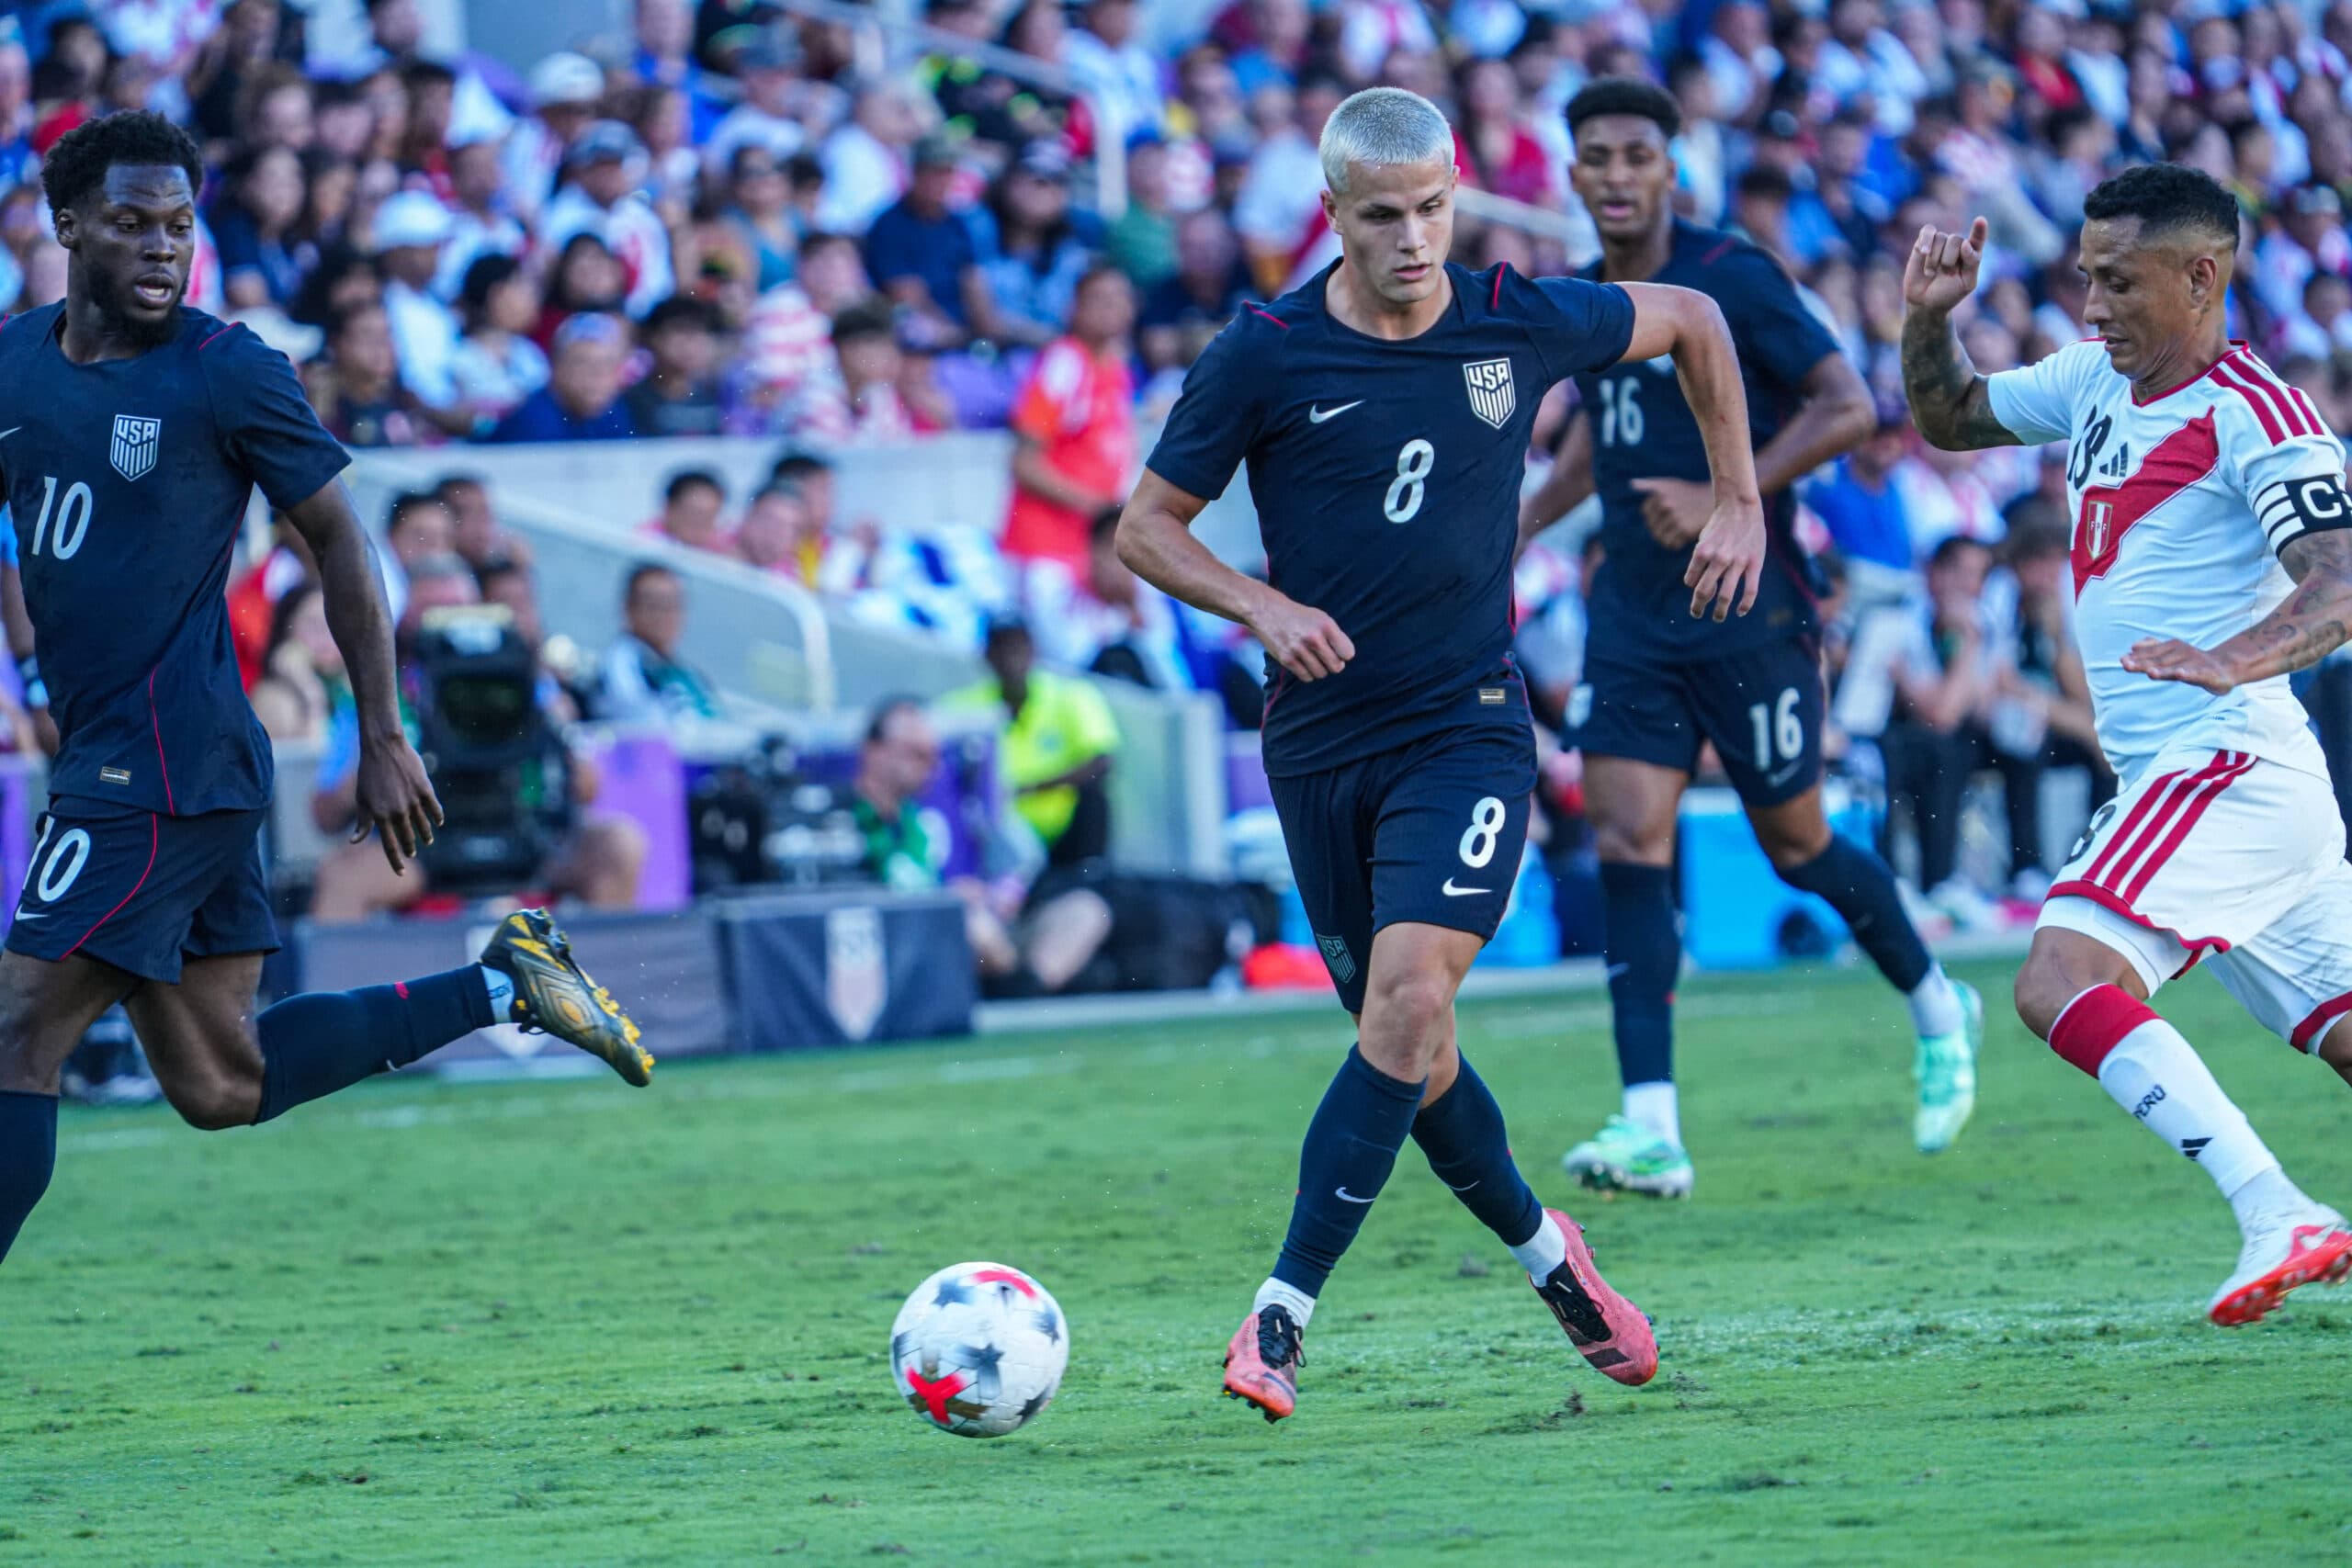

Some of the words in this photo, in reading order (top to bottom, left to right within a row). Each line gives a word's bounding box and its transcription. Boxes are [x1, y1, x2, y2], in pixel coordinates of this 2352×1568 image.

[1468, 363, 1510, 390] USA
[117, 418, 156, 445] USA
[1600, 378, 1645, 448] 16
[1384, 439, 1435, 524] 8
[2301, 480, 2343, 519] C
[31, 476, 93, 560] 10
[1748, 687, 1804, 771] 16
[23, 815, 91, 902] 10
[1458, 796, 1506, 868] 8
[1319, 938, 1345, 957] USA
